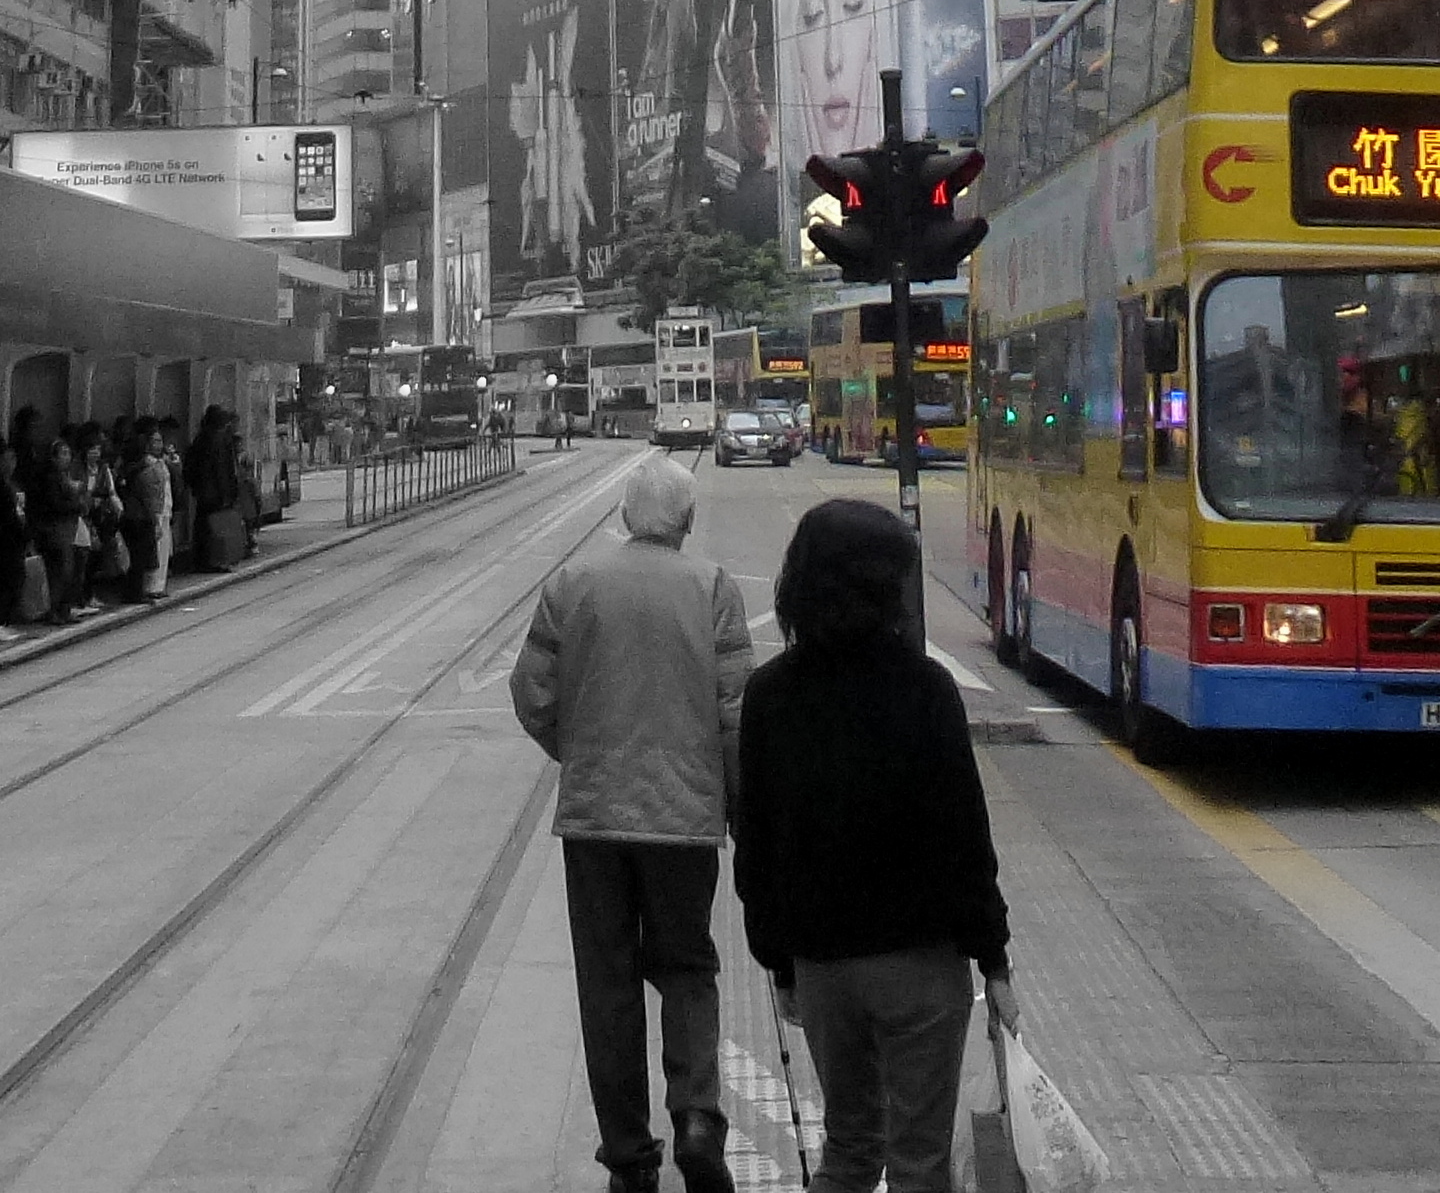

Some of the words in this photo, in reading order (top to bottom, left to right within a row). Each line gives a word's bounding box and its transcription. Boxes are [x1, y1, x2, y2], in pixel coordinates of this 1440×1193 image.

[57, 161, 122, 174] Experience
[125, 160, 165, 172] iPhone
[167, 160, 182, 171] 5s
[73, 174, 133, 187] Dual-Band
[135, 174, 152, 186] 4G
[154, 173, 176, 185] LTE
[178, 173, 226, 184] Network
[1327, 167, 1402, 197] Chuk
